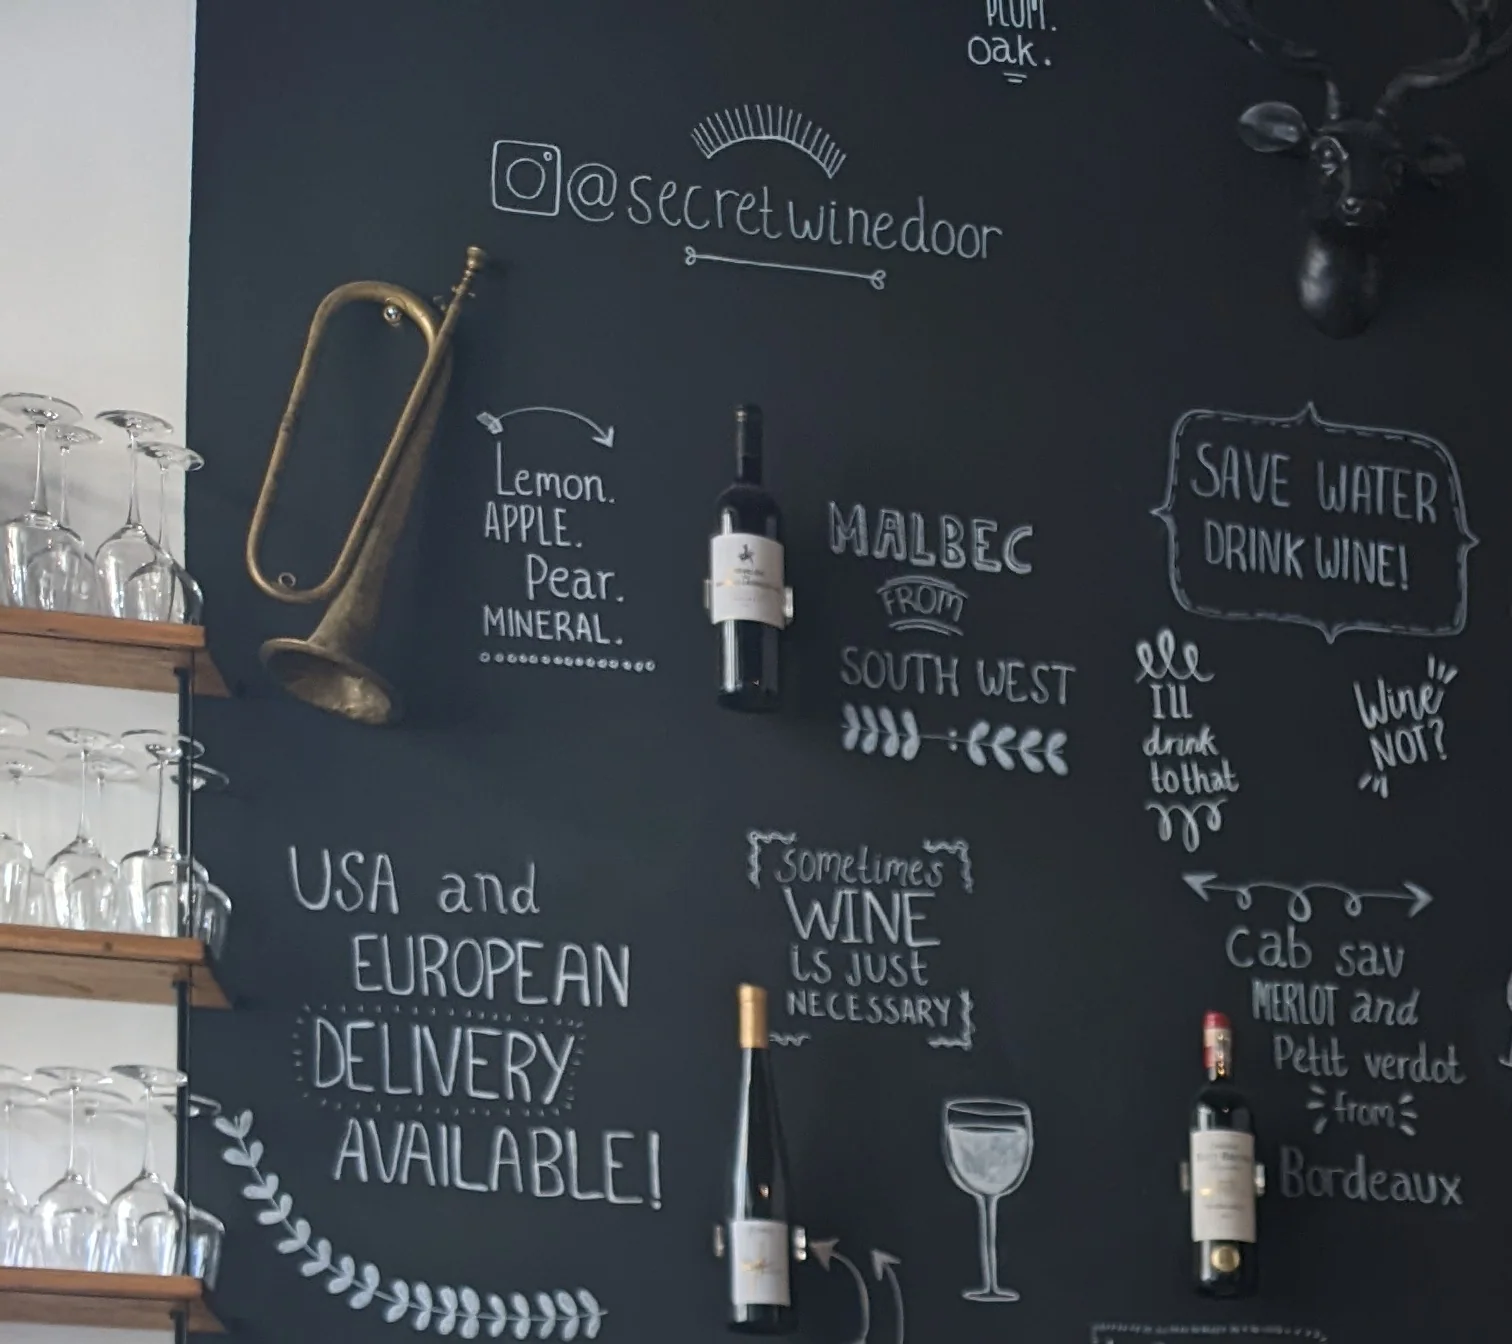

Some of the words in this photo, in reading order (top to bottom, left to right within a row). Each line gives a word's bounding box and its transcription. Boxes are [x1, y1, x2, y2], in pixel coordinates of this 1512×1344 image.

[567, 163, 1003, 259] @secretwinedoor
[496, 439, 615, 504] Lemon.
[1191, 442, 1291, 508] SAVE
[1317, 461, 1438, 524] WATER
[484, 501, 583, 548] APPLE.
[828, 500, 1033, 575] MALBEC
[526, 553, 624, 603] Pear.
[1204, 519, 1305, 580] DRINK
[1315, 537, 1409, 591] WINE!
[483, 605, 623, 645] MINERAL.
[883, 584, 965, 623] FROM
[841, 646, 960, 697] SOUTH
[976, 659, 1077, 705] WEST
[1142, 725, 1219, 757] drink
[1367, 717, 1448, 772] NOT?
[289, 845, 399, 915] USA
[438, 862, 541, 915] and
[783, 886, 941, 949] WINE
[352, 933, 630, 1011] EUROPEAN
[1335, 943, 1405, 978] sav
[787, 989, 951, 1027] NECESSARY
[1251, 978, 1340, 1027] MERLOT
[1350, 989, 1420, 1026] and
[313, 1016, 576, 1105] DELIVERY
[1273, 1034, 1349, 1078] Petit
[1364, 1041, 1466, 1085] verdot
[1333, 1090, 1396, 1128] from
[333, 1117, 662, 1210] AVAILABLE!
[1282, 1147, 1463, 1206] Bordeaux
